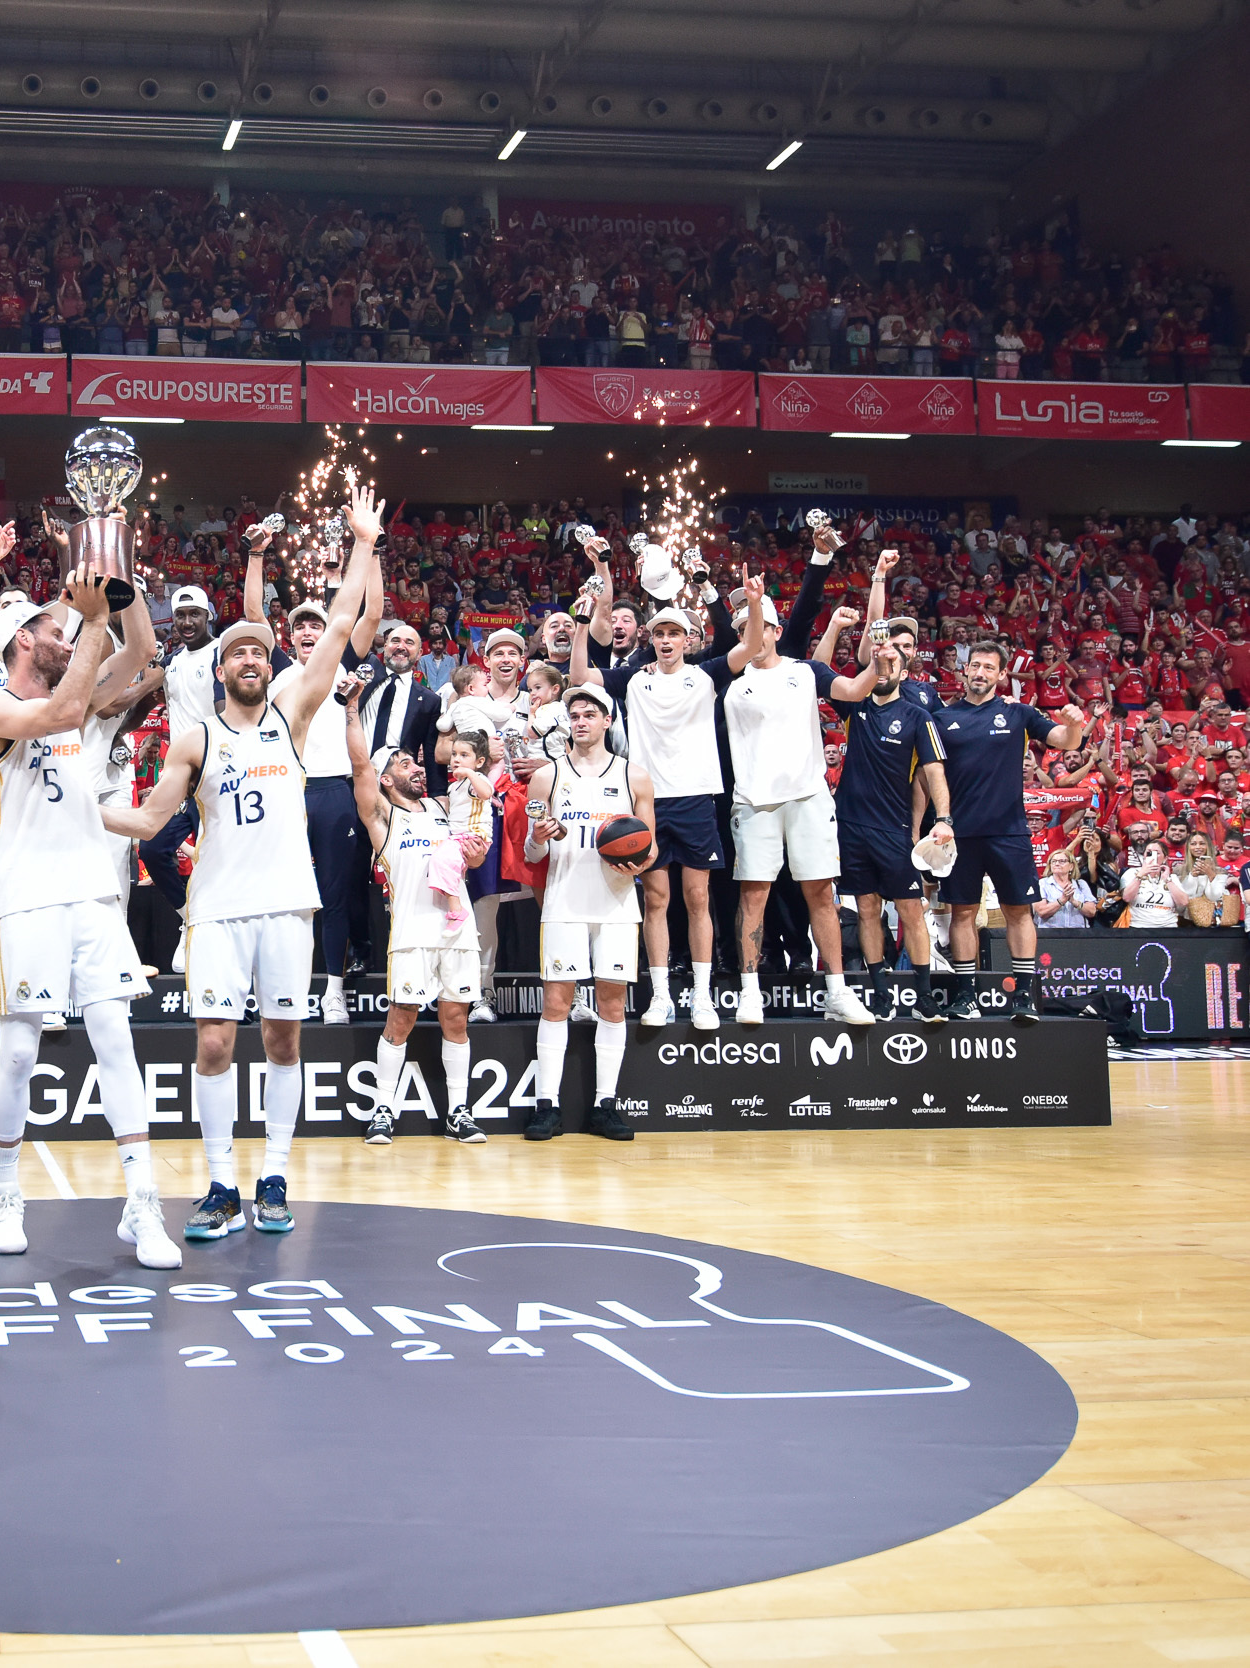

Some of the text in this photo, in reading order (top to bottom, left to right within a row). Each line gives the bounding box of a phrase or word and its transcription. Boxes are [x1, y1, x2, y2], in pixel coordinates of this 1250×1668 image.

[531, 211, 696, 237] Auntamiento
[115, 378, 293, 404] GRUPOSURESTE
[781, 401, 811, 414] Niña
[855, 402, 882, 415] Niña
[927, 404, 955, 416] Niña
[824, 477, 863, 490] Norte
[490, 617, 513, 625] MURCIA
[42, 768, 64, 803] 5
[234, 790, 265, 825] 13
[1145, 890, 1165, 905] 22
[1051, 964, 1122, 980] endesa
[519, 986, 544, 1014] NAD
[658, 1032, 780, 1065] endesa
[951, 1037, 1017, 1060] IONOS
[731, 1094, 764, 1108] renfe
[1022, 1095, 1068, 1105] ONEBOX
[665, 1103, 713, 1117] SPALDING
[789, 1105, 832, 1117] LOTUS
[967, 1103, 995, 1112] Halcón
[233, 1300, 711, 1339] FINAL
